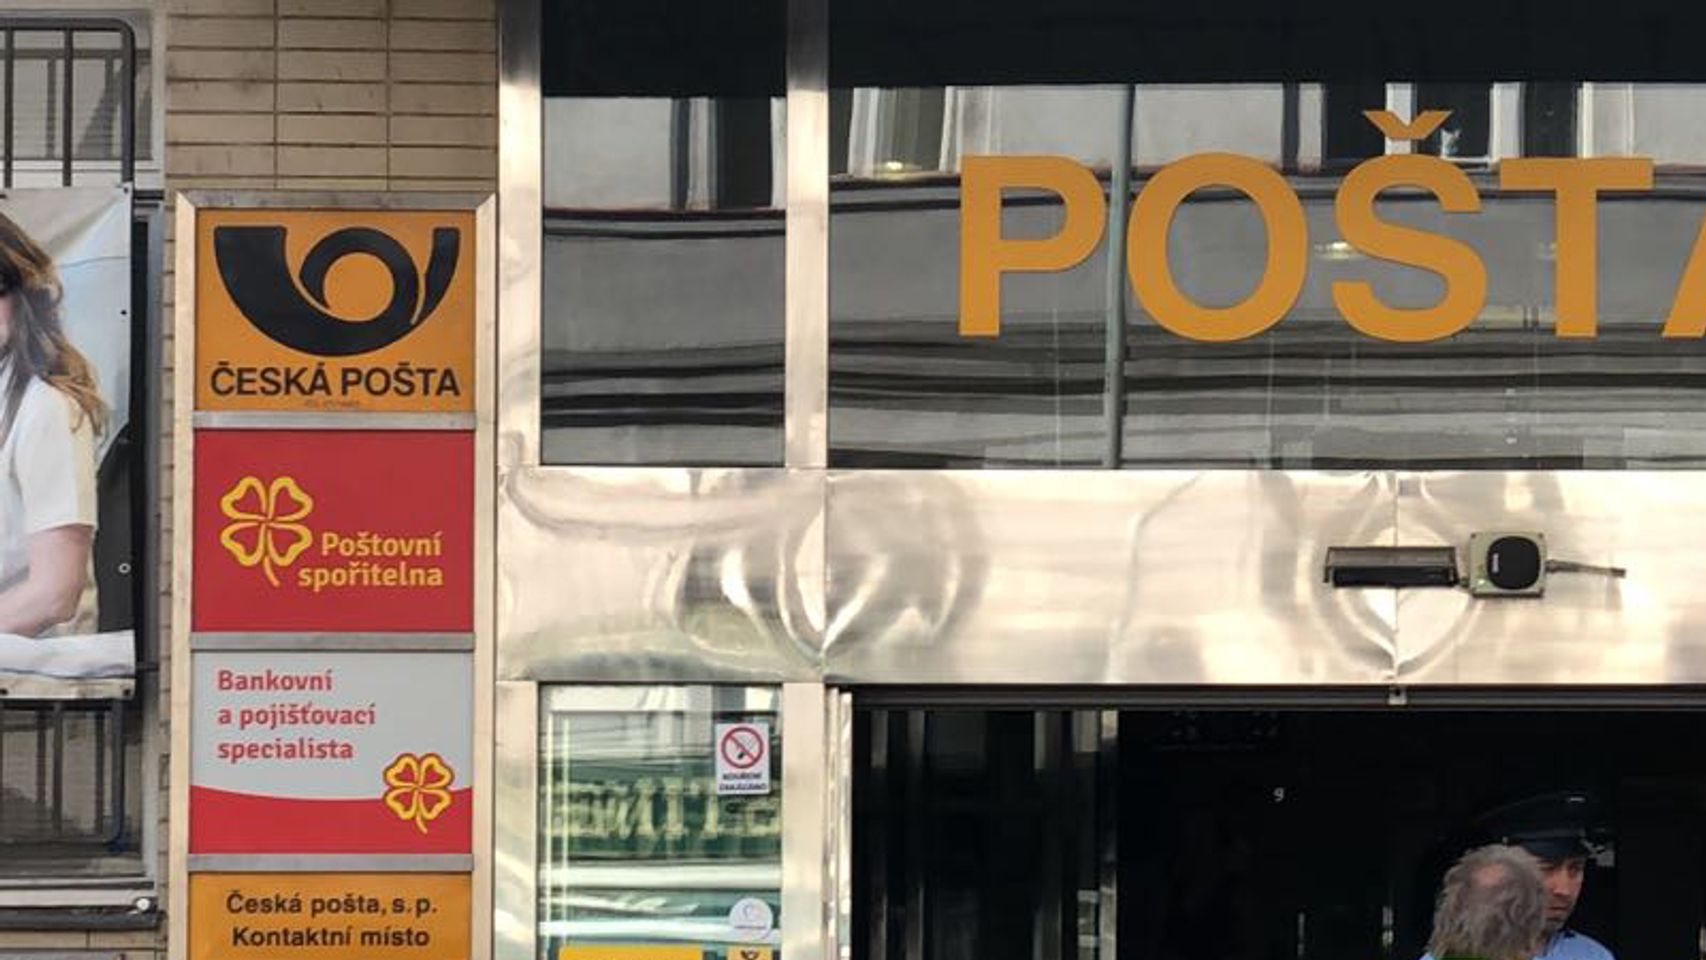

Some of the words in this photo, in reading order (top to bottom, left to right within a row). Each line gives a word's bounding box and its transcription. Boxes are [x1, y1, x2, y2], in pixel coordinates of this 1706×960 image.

[211, 361, 331, 396] ČESKÁ
[341, 362, 460, 396] POŠTA
[321, 532, 442, 557] Poštovní
[299, 562, 444, 592] spořitelna
[218, 669, 332, 691] Bankovní
[218, 709, 232, 725] a
[239, 703, 376, 730] pojišťovací
[218, 738, 354, 764] specialista
[226, 890, 302, 914] Česká
[310, 893, 388, 918] pošta,
[232, 926, 352, 947] Kontaktní
[360, 926, 430, 947] místo
